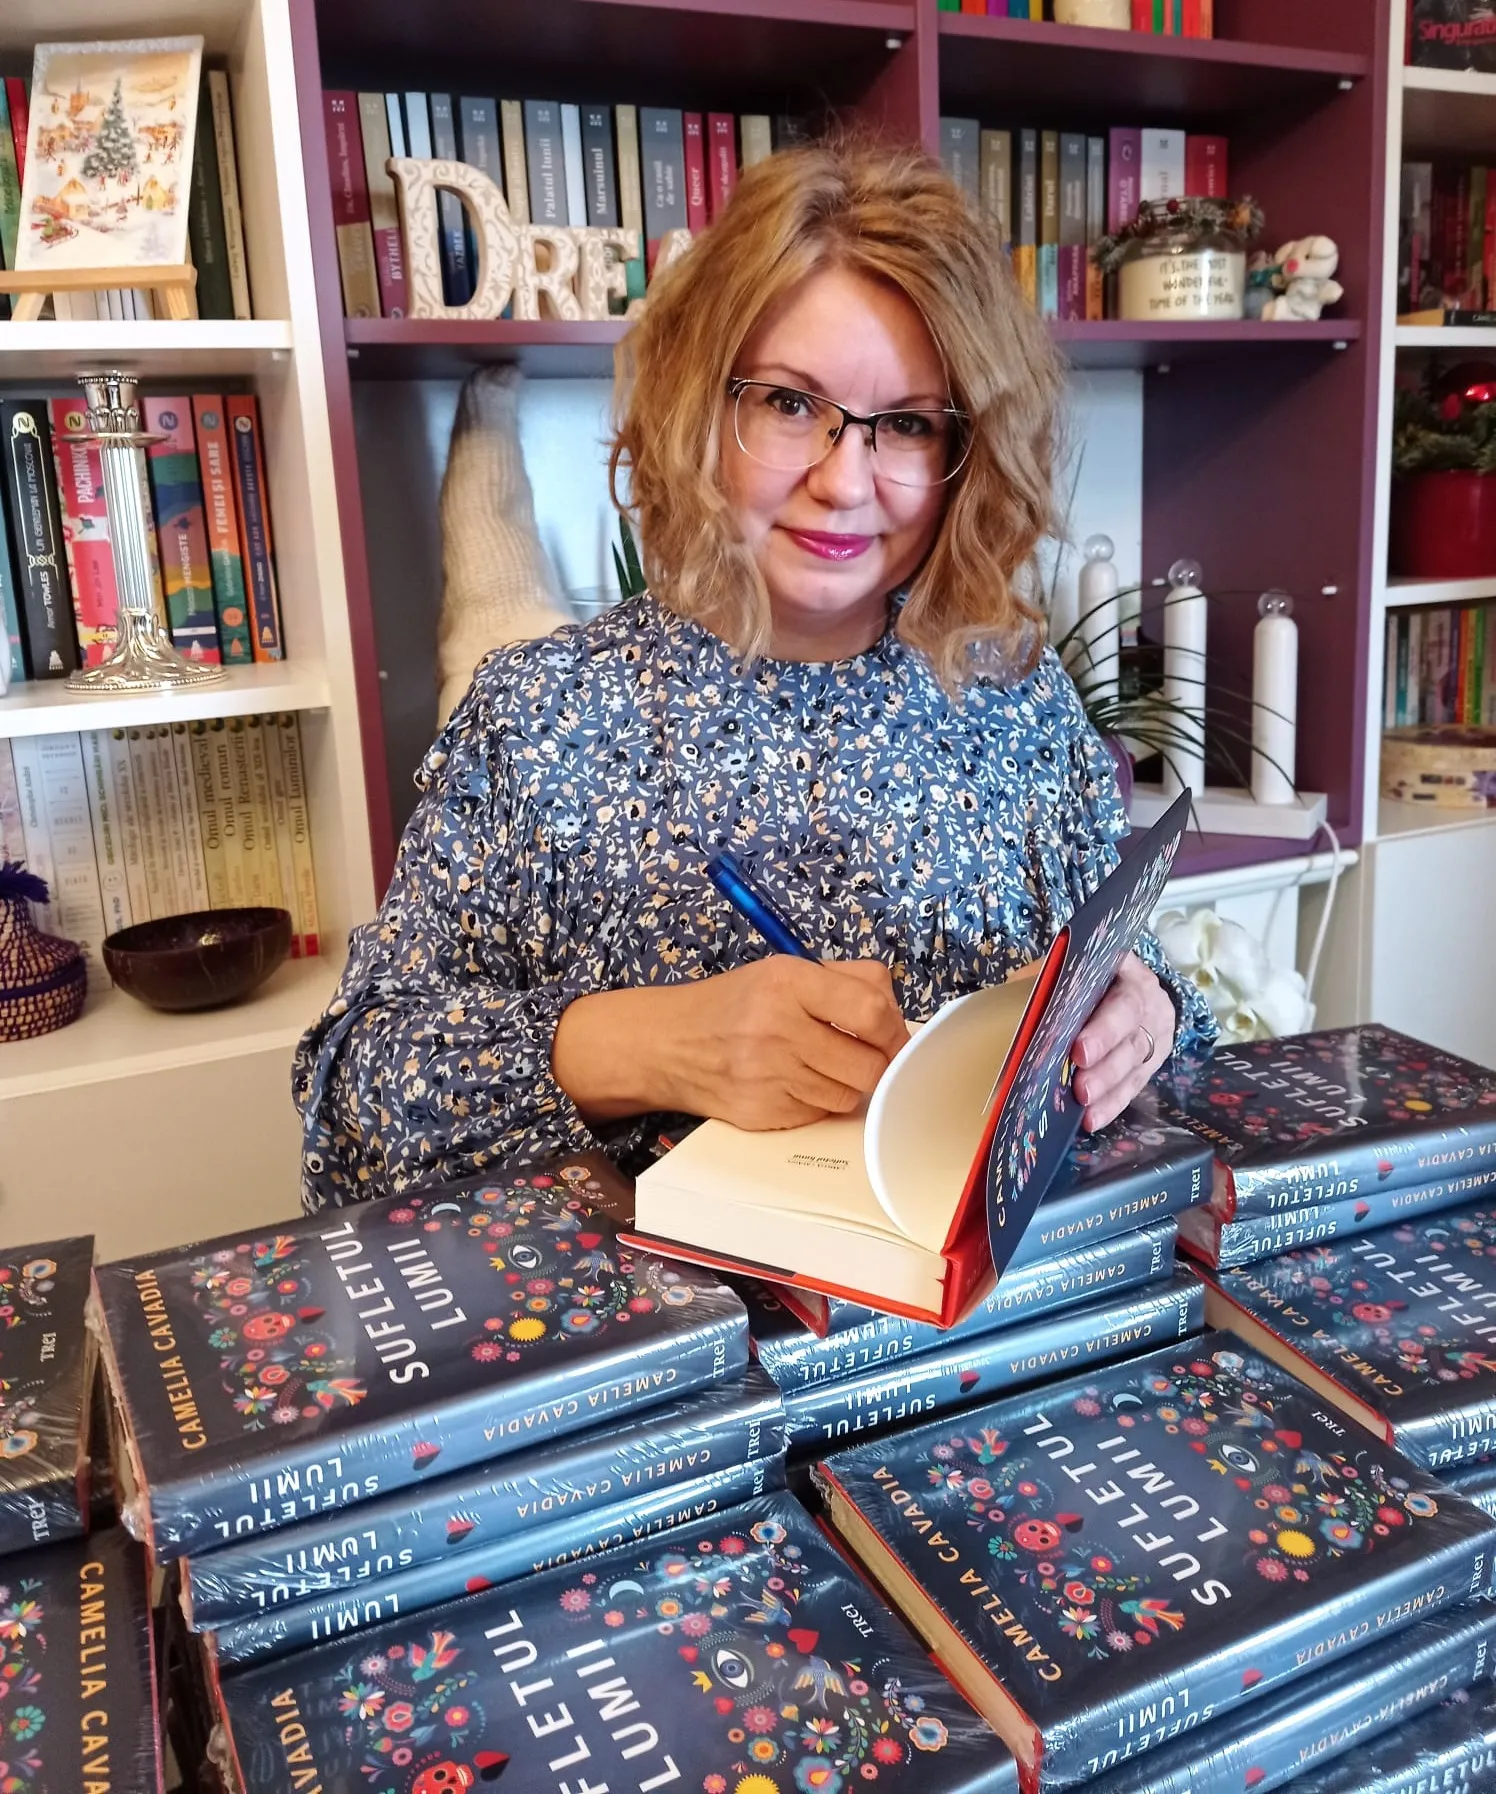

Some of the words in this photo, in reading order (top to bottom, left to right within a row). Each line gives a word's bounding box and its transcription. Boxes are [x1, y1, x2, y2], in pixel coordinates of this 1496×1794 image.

[543, 171, 556, 219] Palatul
[690, 166, 706, 207] Queer
[1163, 276, 1225, 291] WONDEFUL
[207, 440, 223, 476] SARE
[213, 494, 229, 535] FEMEI
[177, 532, 192, 585] MENGISTE
[39, 570, 53, 606] TOWLES
[195, 738, 216, 803] medieval
[215, 744, 232, 791] roman
[283, 734, 302, 800] Luminilor
[202, 809, 221, 851] Omul
[220, 796, 236, 838] Omul
[239, 811, 256, 851] Omul
[291, 805, 305, 845] Omul
[1214, 1052, 1369, 1128] SUFLETUL
[1270, 1061, 1367, 1104] LUMII
[1418, 1147, 1473, 1168] CAVADIA
[1109, 1190, 1168, 1221] CAMELIA
[1268, 1178, 1359, 1209] SUFLETUL
[1391, 1185, 1443, 1208] CAVADIA
[1041, 1213, 1104, 1245] CAVADIA
[1252, 1221, 1337, 1254] SUFLETUL
[386, 1238, 467, 1331] LUMII
[986, 1282, 1054, 1314] CAVADIA
[1064, 1263, 1126, 1293] CAMELIA
[1230, 1265, 1312, 1326] CAVADIA
[135, 1268, 178, 1351] CAVADIA
[320, 1220, 431, 1385] SUFLETUL
[800, 1334, 913, 1381] SUFLETUL
[1086, 1322, 1152, 1352] CAMELIA
[1010, 1345, 1079, 1375] CAVADIA
[1311, 1328, 1403, 1396] CAMELIA
[160, 1355, 208, 1450] CAMELIA
[588, 1368, 677, 1408] CAMELIA
[483, 1400, 579, 1442] CAVADIA
[822, 1393, 937, 1440] SUFLETUL
[250, 1456, 344, 1504] LUMII
[621, 1449, 711, 1487] CAMELIA
[1097, 1435, 1229, 1543] LUMII
[215, 1474, 380, 1538] SUFLETUL
[516, 1479, 612, 1519] CAVADIA
[632, 1498, 718, 1538] CAMELIA
[872, 1465, 960, 1563] CAVADIA
[1023, 1413, 1232, 1607] SUFLETUL
[286, 1530, 379, 1575] LUMII
[532, 1532, 624, 1572] CAVADIA
[250, 1548, 414, 1608] SUFLETUL
[311, 1593, 401, 1640] LUMII
[959, 1567, 1064, 1682] CAMELIA
[1376, 1584, 1446, 1627] CAMELIA
[80, 1562, 109, 1699] CAMELIA
[1296, 1621, 1370, 1666] CAVADIA
[566, 1638, 682, 1793] LUMII
[1117, 1687, 1191, 1739] LUMII
[1086, 1702, 1214, 1775] SUFLETUL
